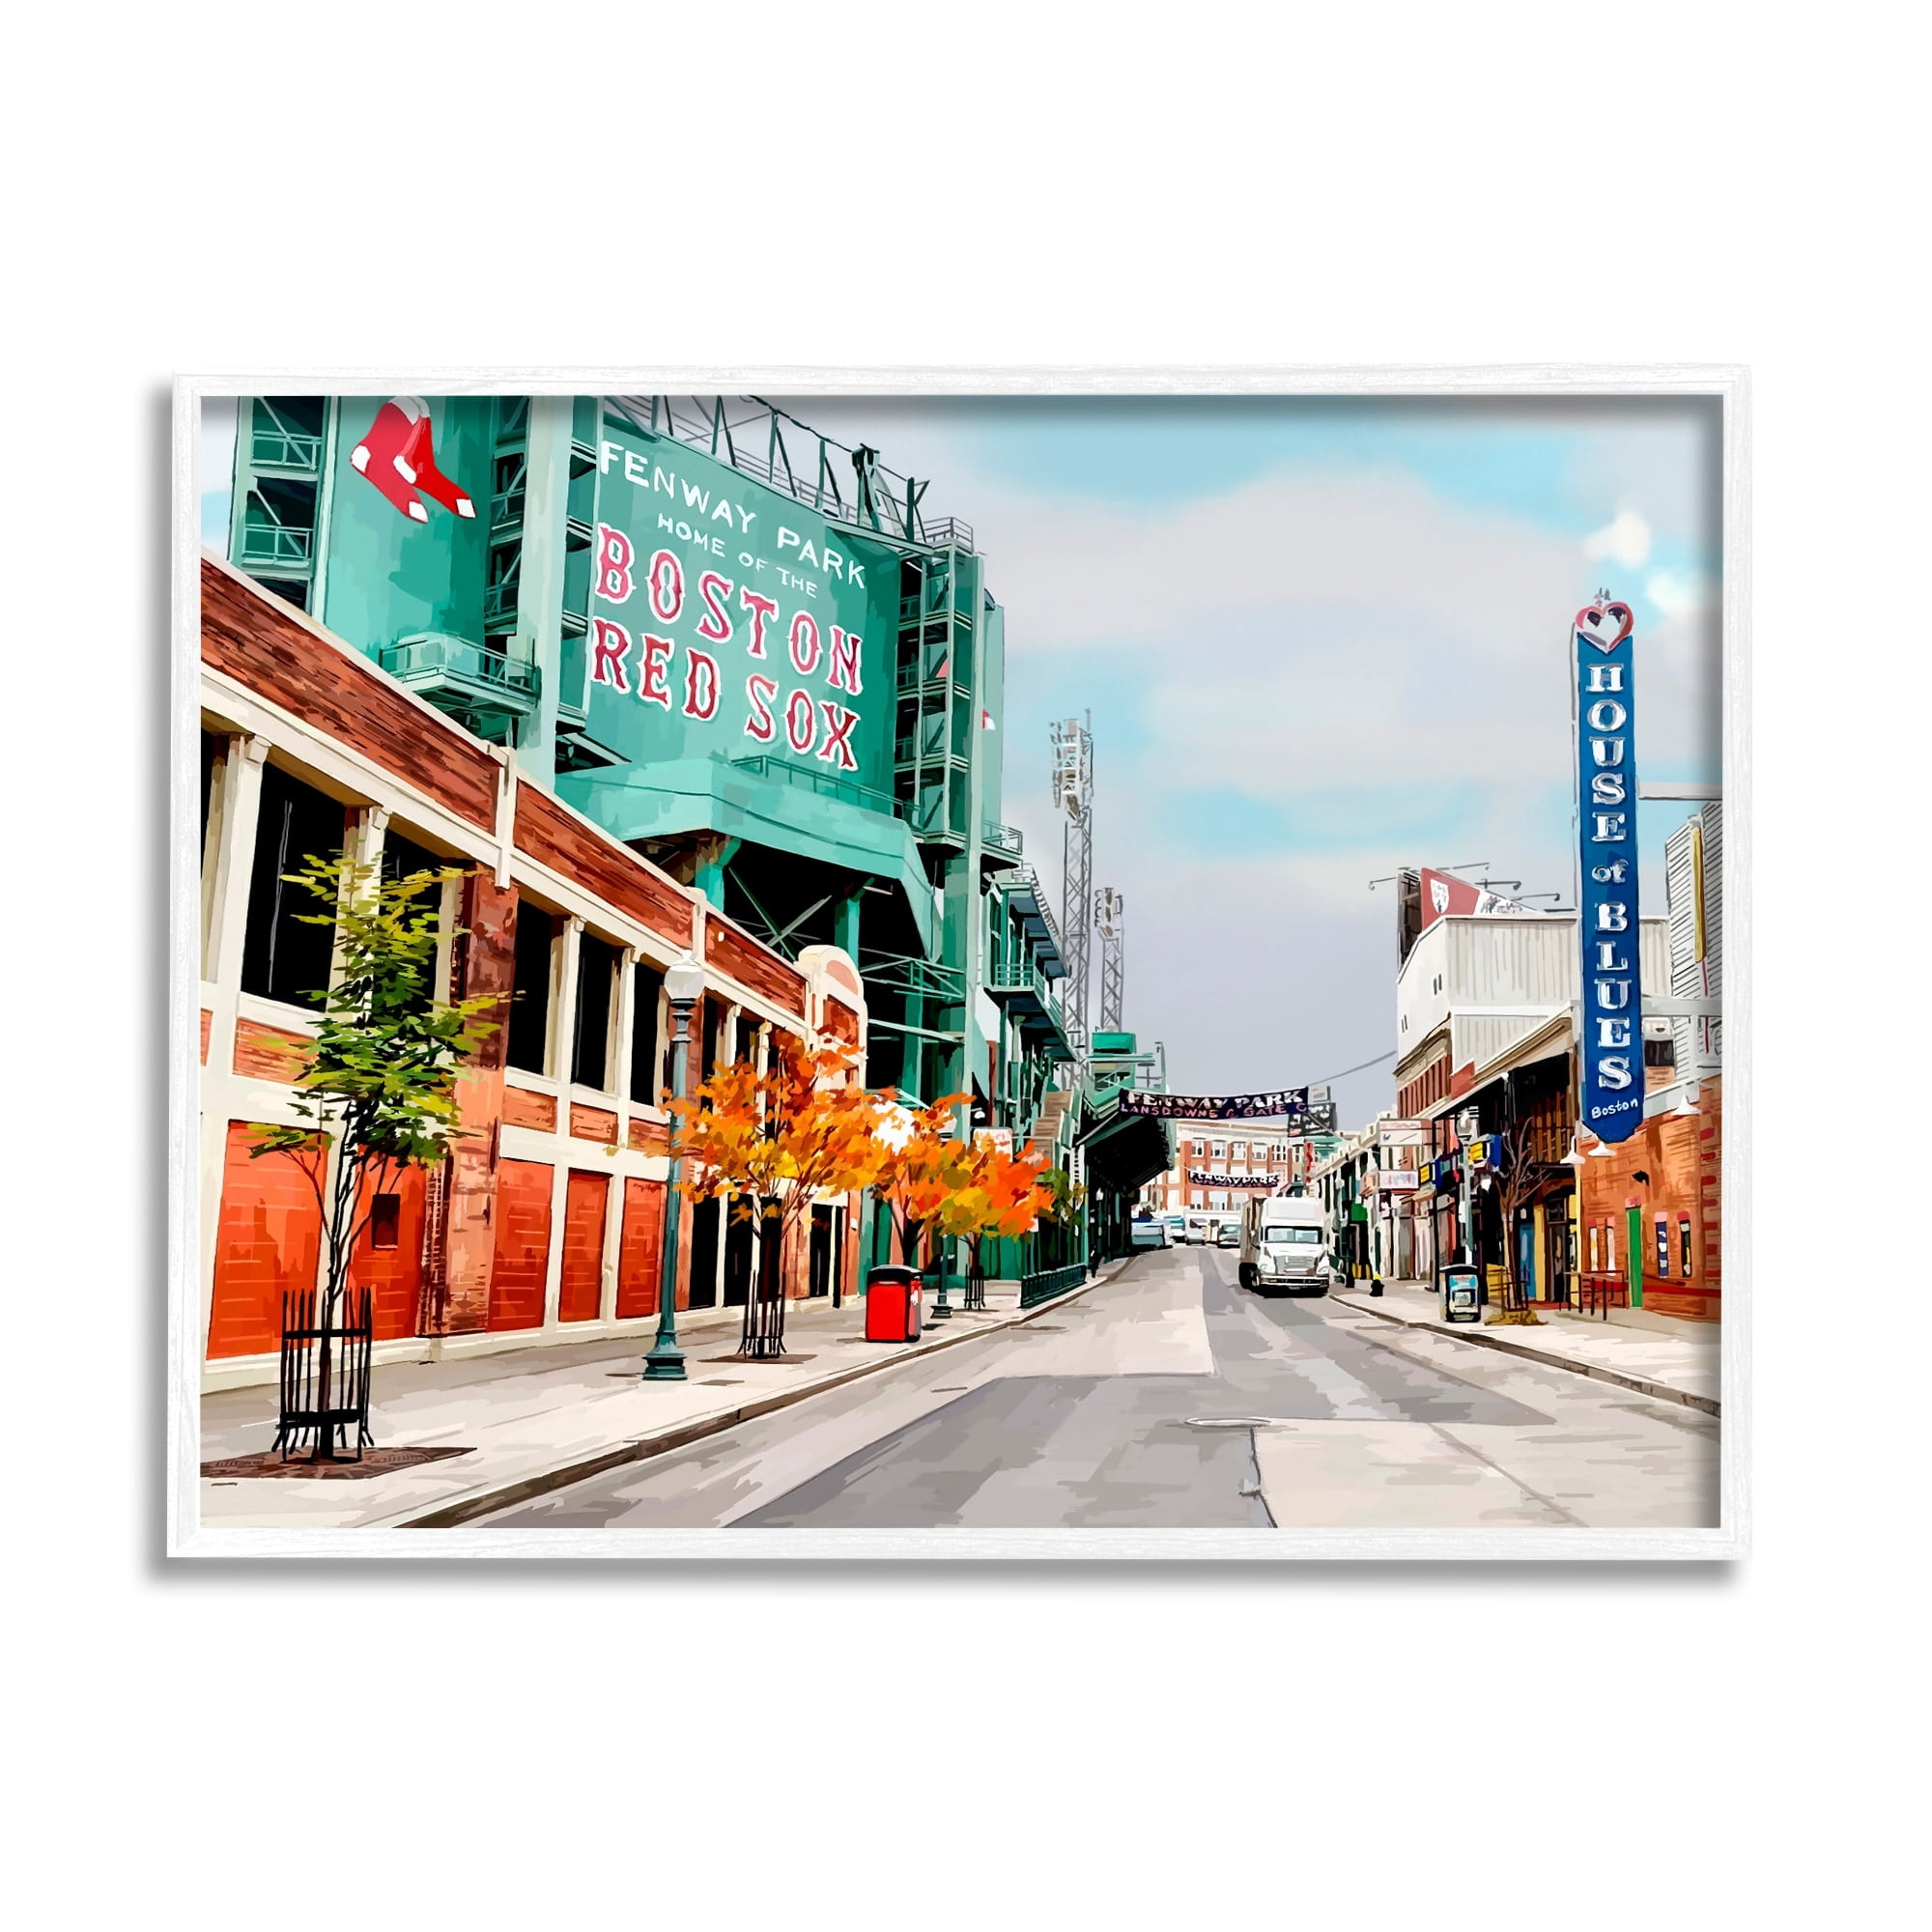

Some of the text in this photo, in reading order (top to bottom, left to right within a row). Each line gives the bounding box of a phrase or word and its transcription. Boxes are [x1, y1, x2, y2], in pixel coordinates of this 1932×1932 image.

[599, 440, 865, 589] FENWAY PARK
[658, 513, 817, 598] HOME OF THE
[595, 523, 864, 696] BOSTON
[591, 616, 861, 771] RED SOX
[1585, 663, 1627, 842] HOUSE
[1594, 901, 1633, 1090] BLUES
[1121, 1103, 1218, 1119] LANSDOWNE
[1243, 1104, 1287, 1117] GATE
[1127, 1091, 1303, 1110] FENWAY PARK
[1591, 1097, 1638, 1119] Boston
